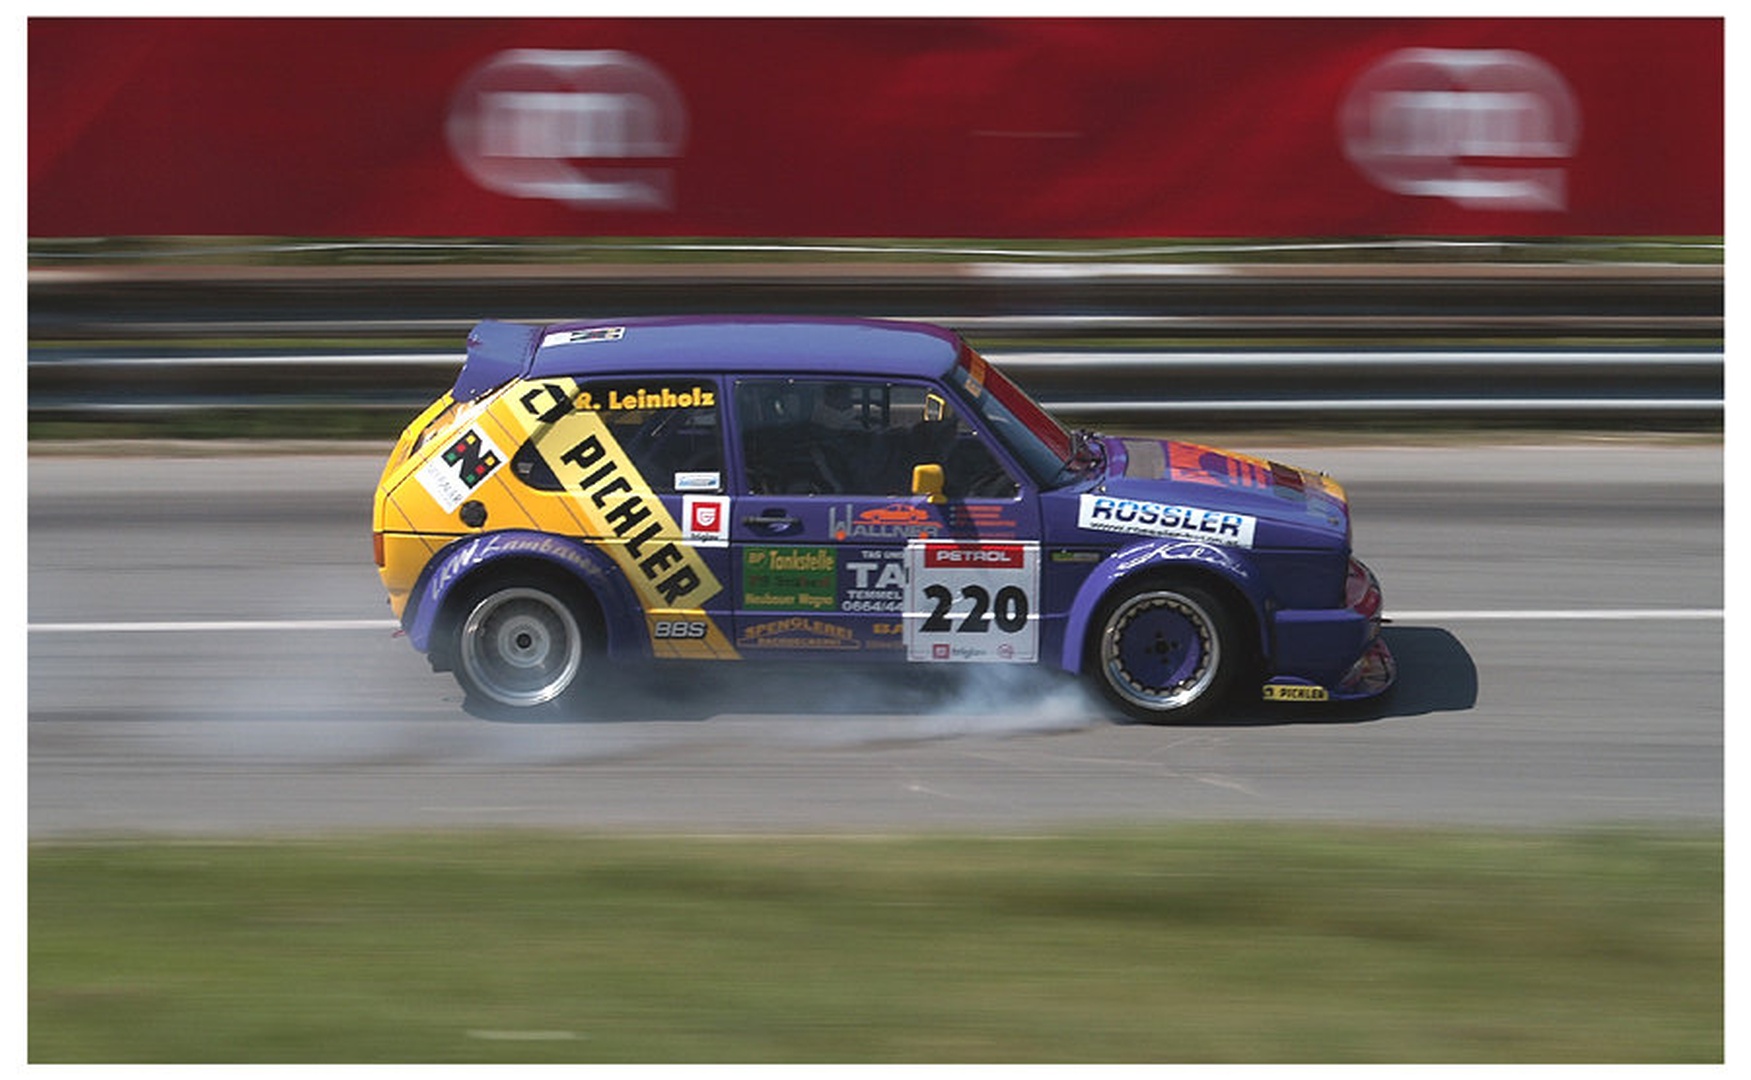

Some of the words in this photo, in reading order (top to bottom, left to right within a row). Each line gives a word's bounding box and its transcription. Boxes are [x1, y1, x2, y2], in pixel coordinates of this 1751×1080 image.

[575, 391, 601, 410] R.
[608, 387, 715, 410] Leinholz
[560, 434, 700, 606] PICHLER
[829, 503, 938, 541] WALLNER
[769, 549, 835, 571] Tankstelle
[861, 550, 882, 559] TAG
[936, 551, 1012, 561] PETROL
[918, 583, 1029, 633] 220
[654, 621, 707, 640] BBS
